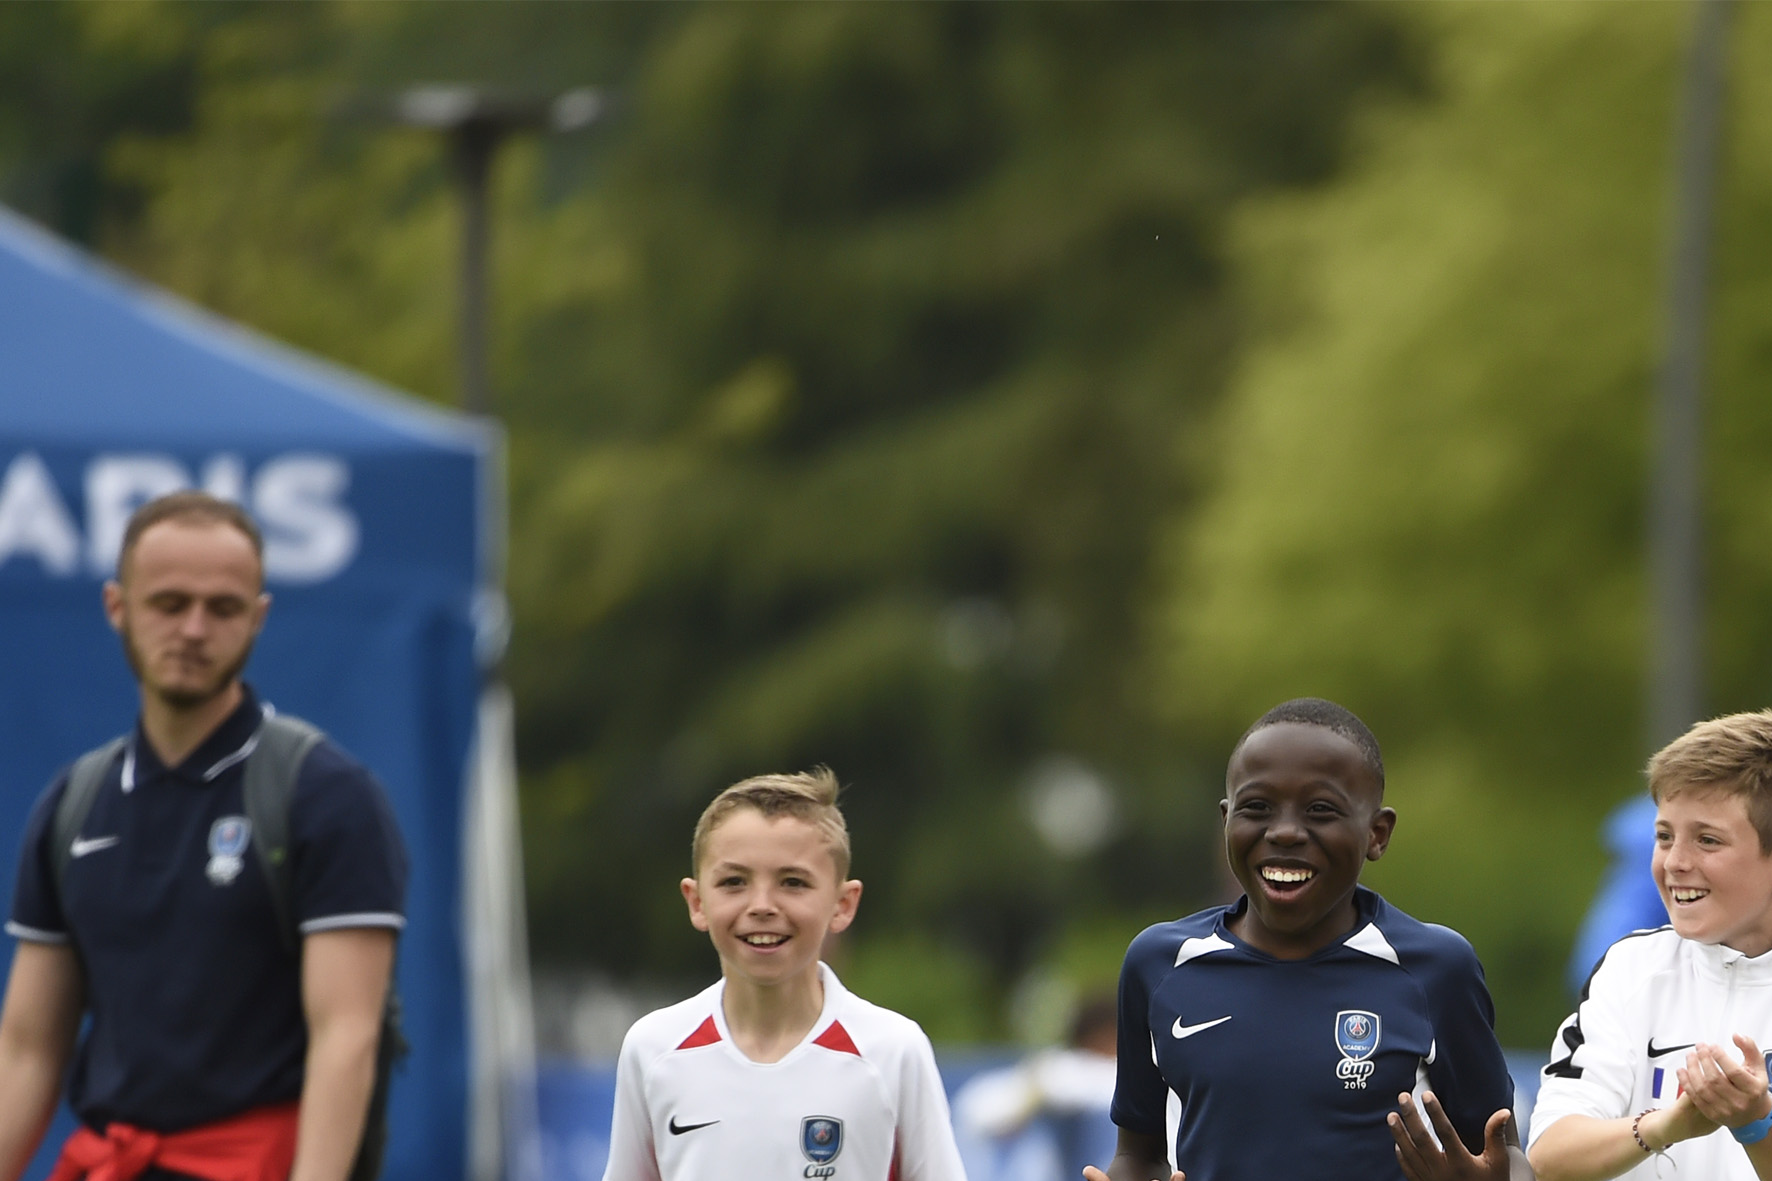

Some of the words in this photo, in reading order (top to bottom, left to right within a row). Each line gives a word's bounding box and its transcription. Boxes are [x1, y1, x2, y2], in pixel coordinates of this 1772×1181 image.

[1337, 1059, 1375, 1082] Cup
[1344, 1081, 1367, 1090] 2019
[803, 1163, 836, 1181] Cup
